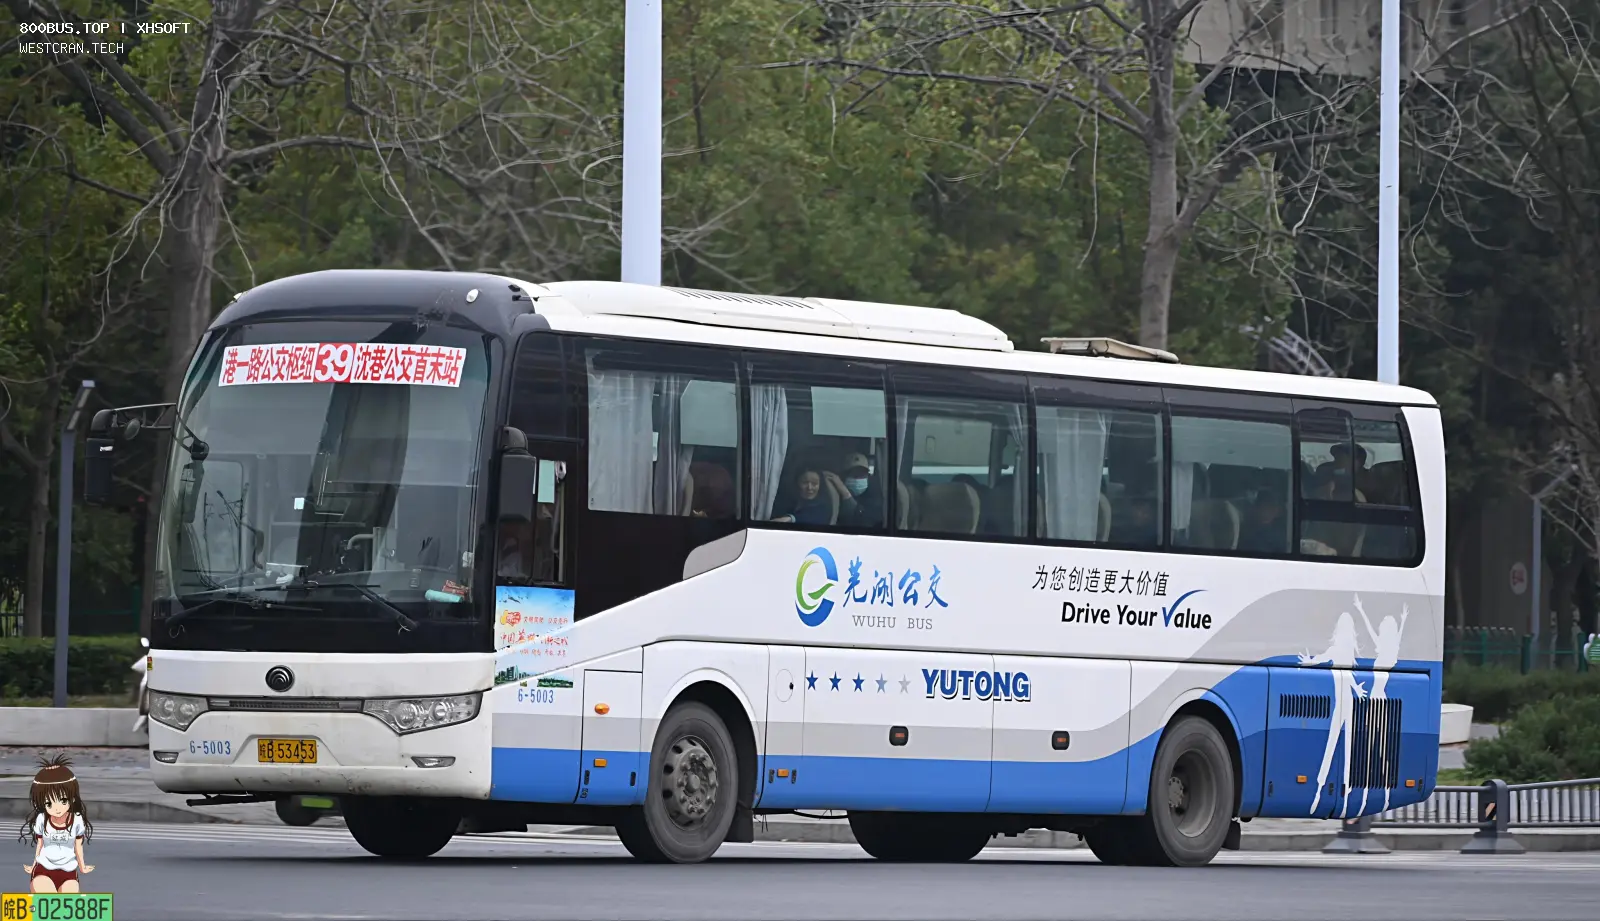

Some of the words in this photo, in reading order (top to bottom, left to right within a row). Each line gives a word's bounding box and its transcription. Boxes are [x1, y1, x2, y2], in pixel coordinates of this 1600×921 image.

[222, 347, 315, 384] 港一路公交枢纽
[314, 343, 354, 382] 39
[354, 347, 463, 385] 沈巷公交首末站
[842, 556, 949, 609] 芜湖公交
[1032, 564, 1170, 597] 为您创造更大价值
[852, 615, 896, 629] WUHU
[907, 617, 933, 630] BUS
[1061, 601, 1111, 625] Drive
[1116, 604, 1158, 627] Your
[1162, 589, 1212, 629] Value
[518, 688, 554, 704] 6-5003
[921, 668, 1031, 702] YUTONG
[189, 740, 231, 755] 6-5003
